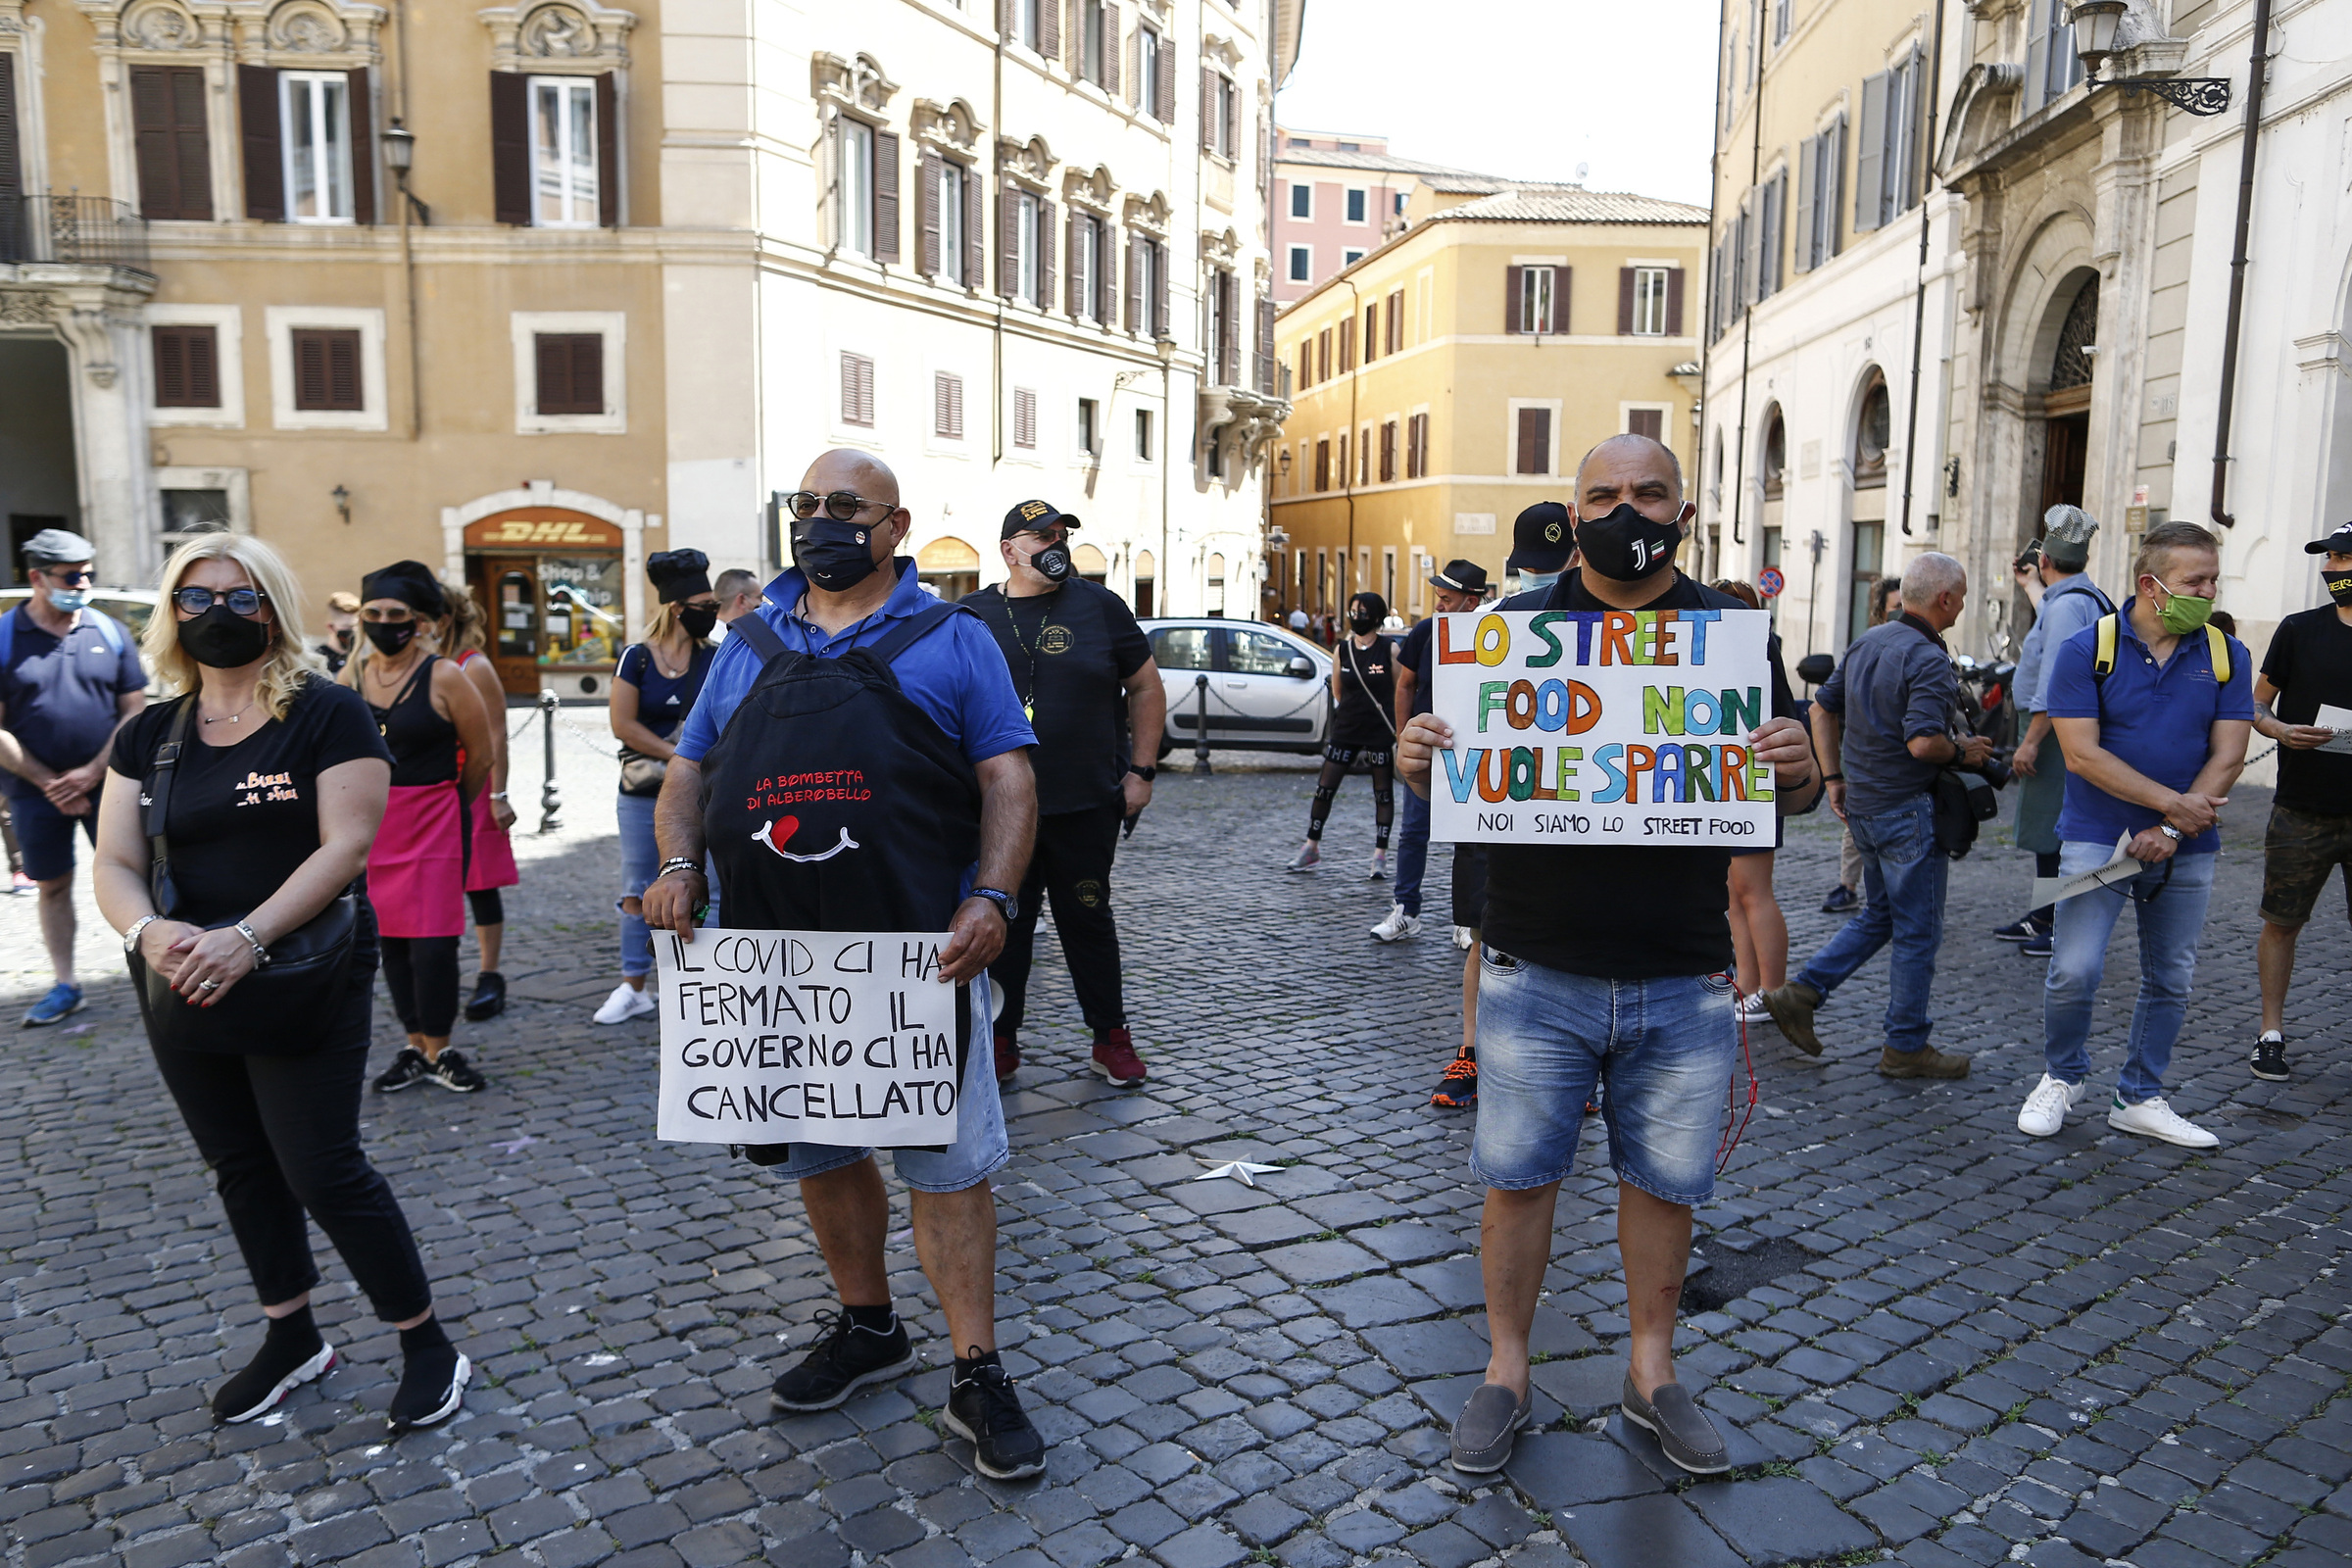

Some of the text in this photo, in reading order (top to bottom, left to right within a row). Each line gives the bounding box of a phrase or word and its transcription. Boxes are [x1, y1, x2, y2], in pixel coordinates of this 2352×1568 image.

[500, 520, 591, 542] DHL
[536, 563, 601, 583] Shop &
[1438, 609, 1722, 667] LO STREET
[1478, 677, 1761, 736] FOOD NON
[756, 769, 863, 792] LA BOMBETTA
[1440, 743, 1775, 804] VUOLE SPARIRE
[746, 788, 871, 811] DI ALBEROBELLO
[1477, 812, 1755, 836] NOI SIAMO LO STREET FOOD
[671, 934, 943, 981] IL COVID CI HA
[679, 981, 925, 1032] FERMATO IL
[682, 1032, 953, 1070] GOVERNO CI HA
[687, 1080, 955, 1123] CANCELLATO
